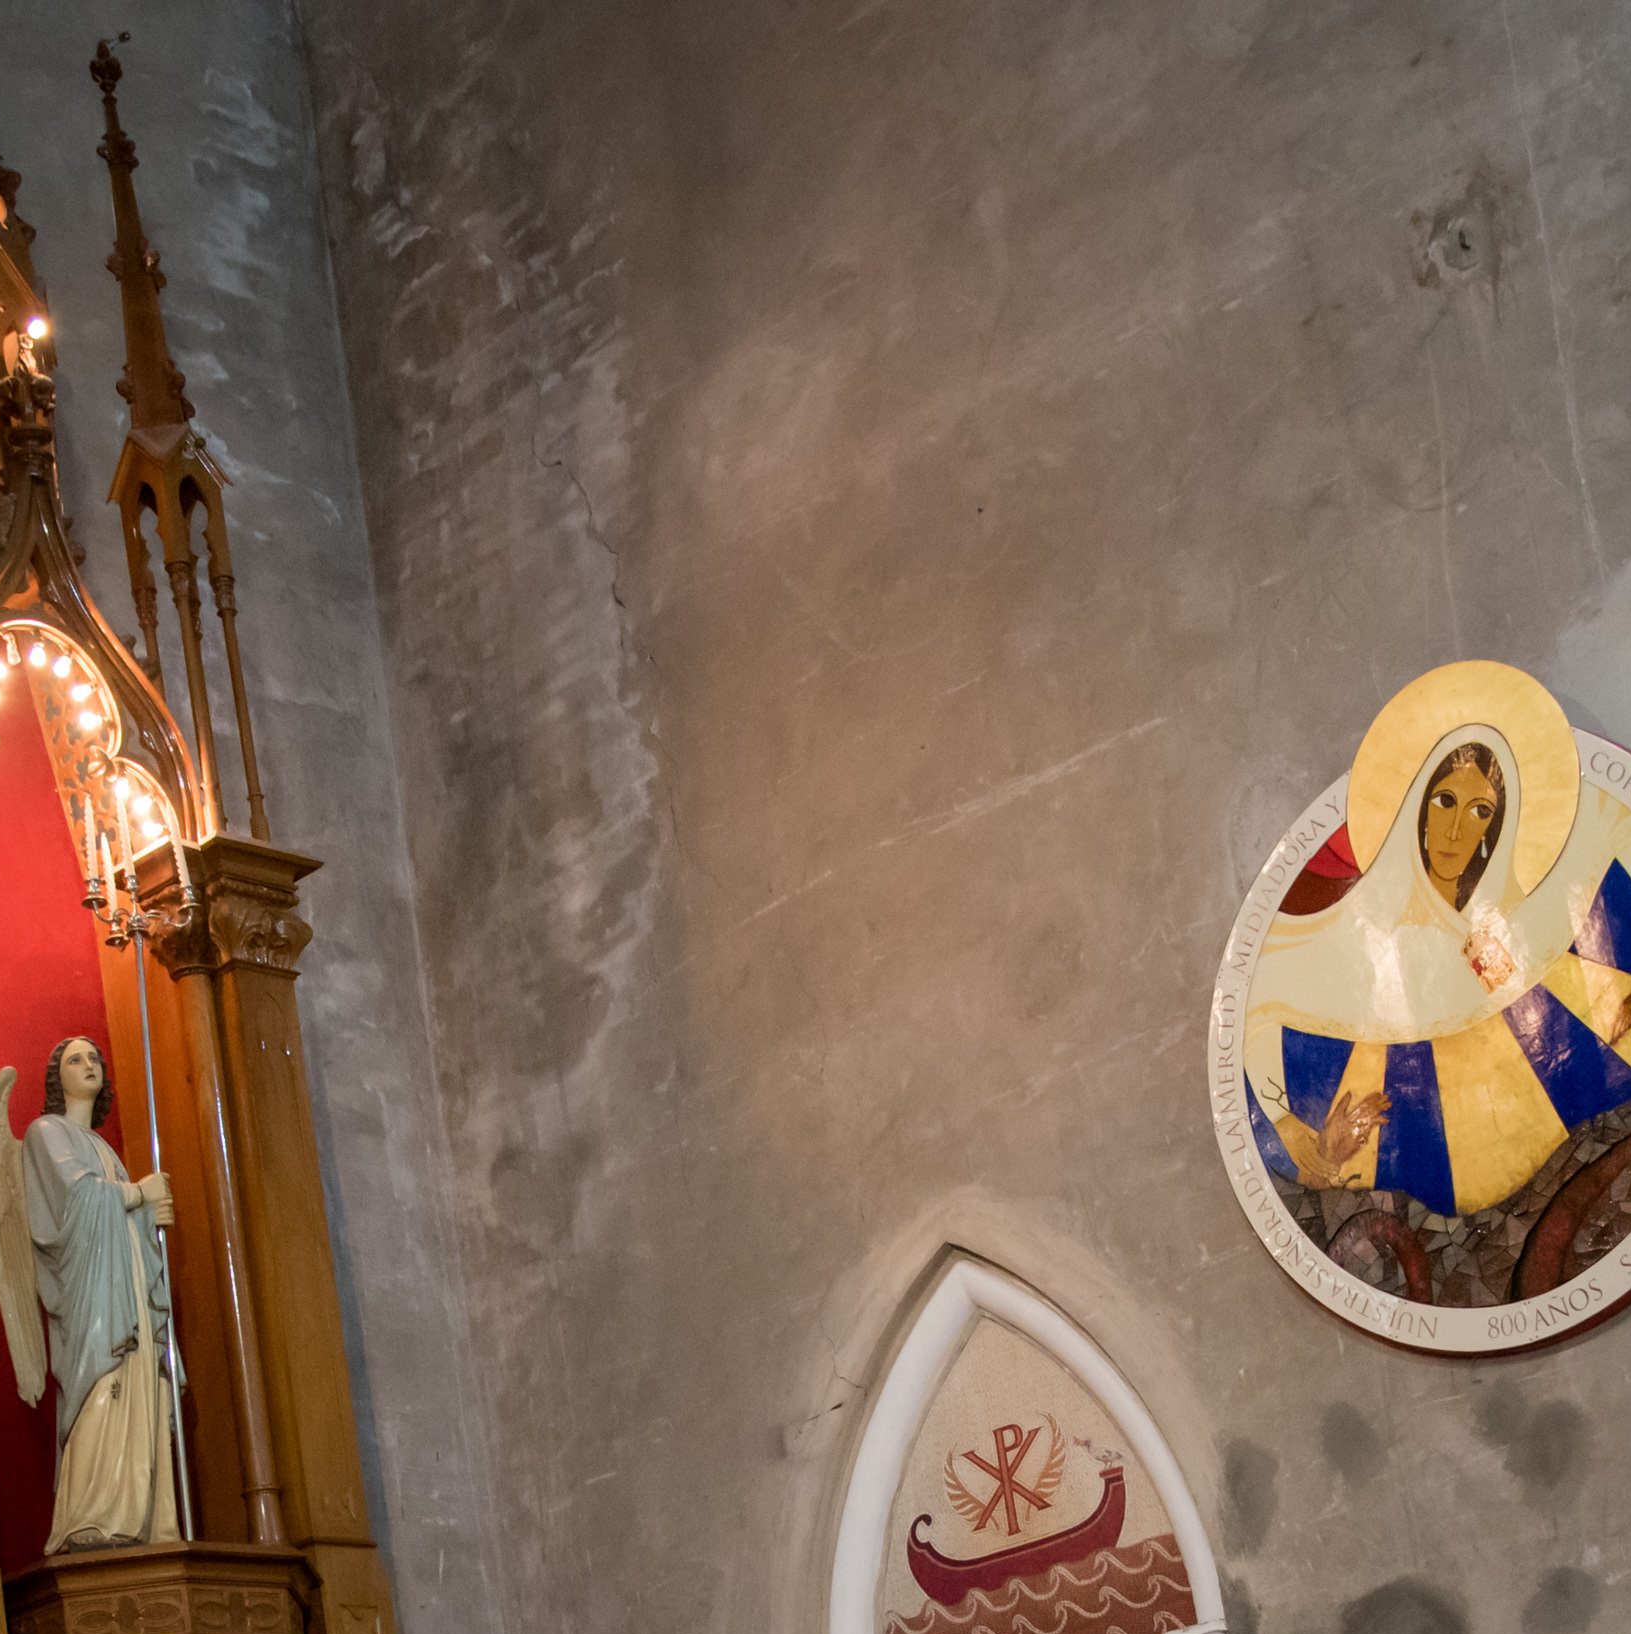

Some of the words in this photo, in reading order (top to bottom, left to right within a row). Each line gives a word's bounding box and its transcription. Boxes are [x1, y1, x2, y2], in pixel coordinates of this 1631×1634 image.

[1325, 795, 1341, 816] Y
[1226, 1122, 1246, 1154] LA
[1239, 1161, 1263, 1198] DE
[1488, 1312, 1527, 1339] 800
[1534, 1278, 1604, 1331] AÑOS
